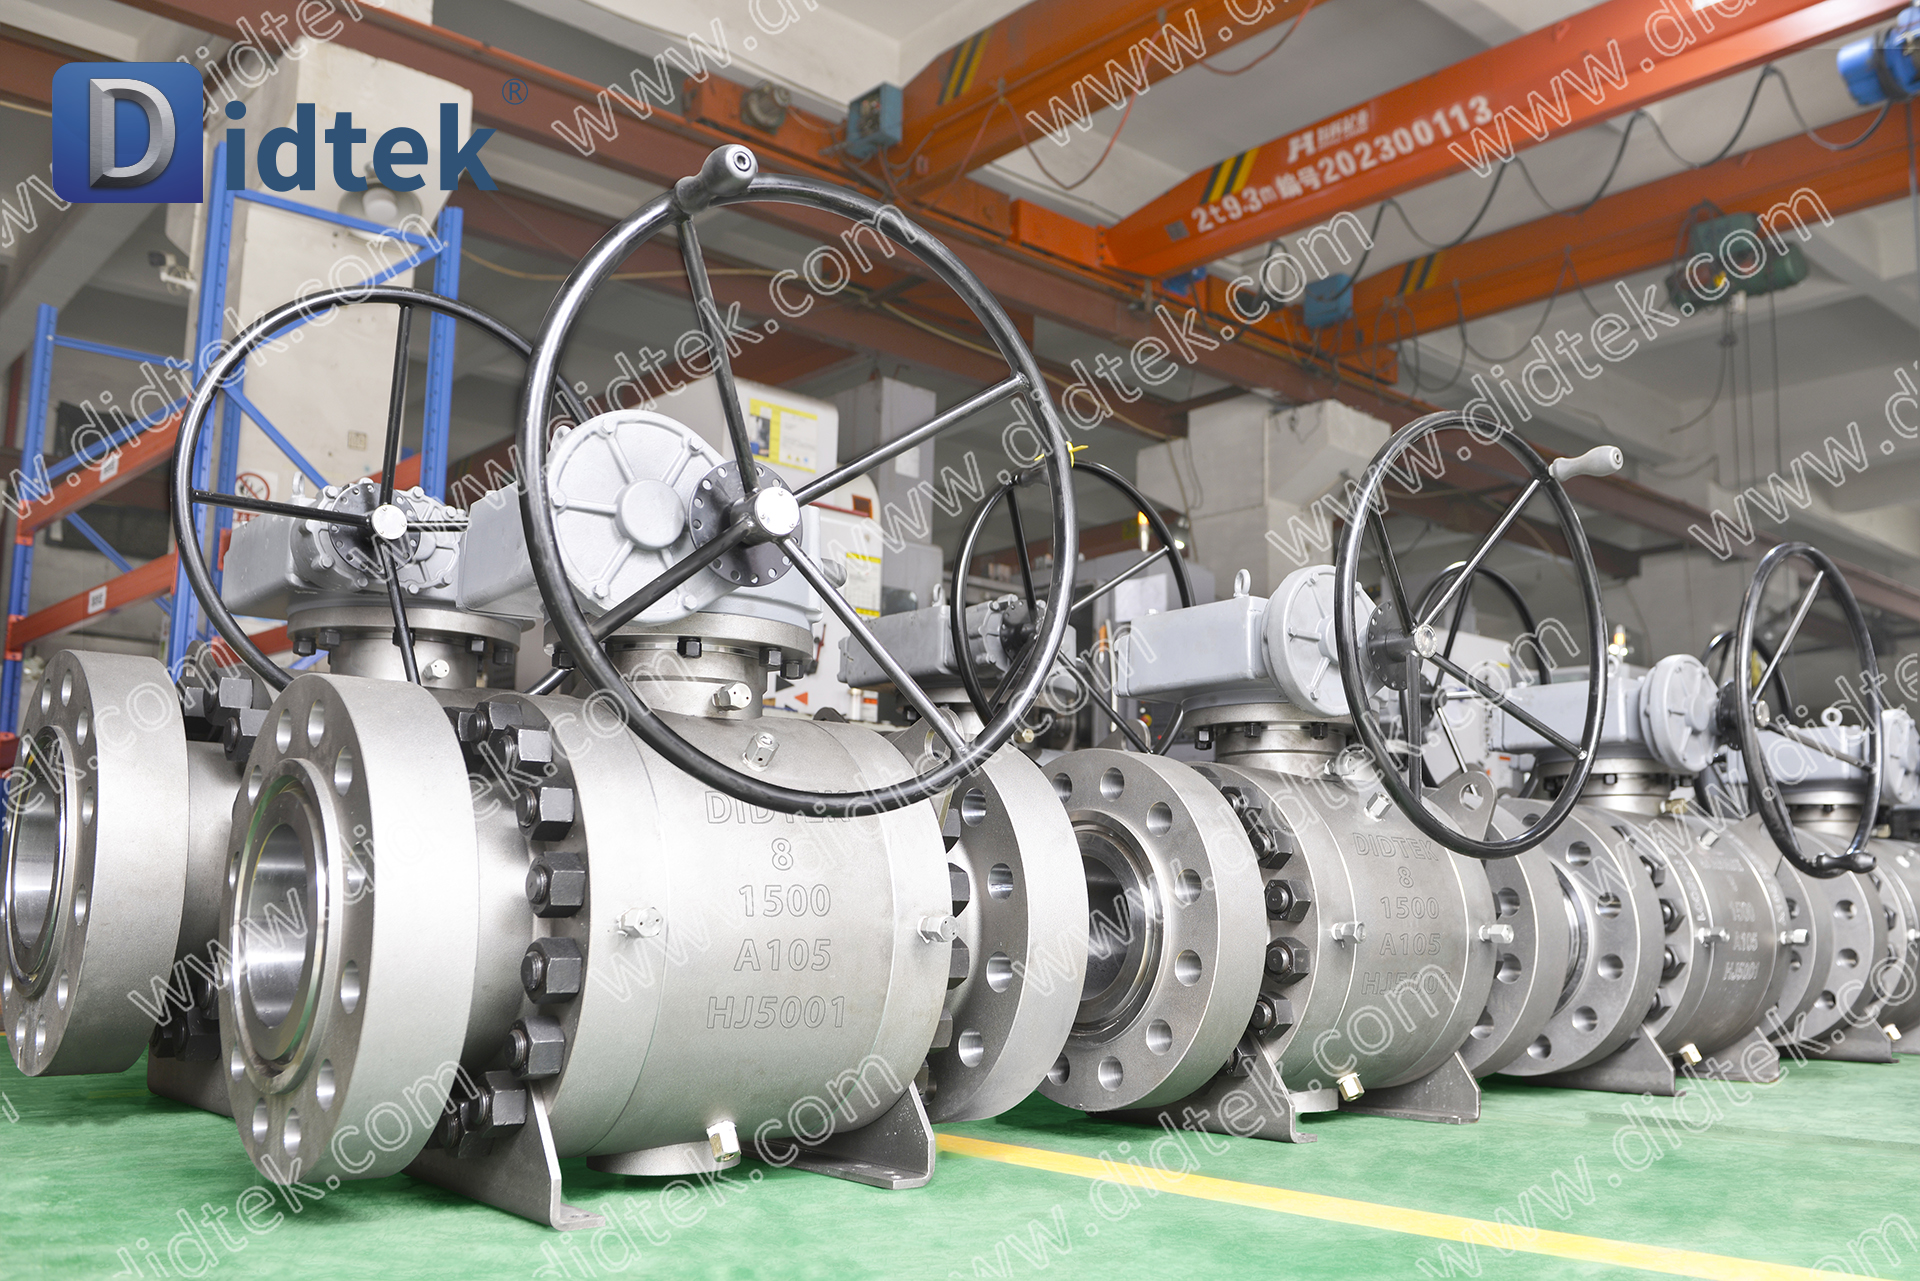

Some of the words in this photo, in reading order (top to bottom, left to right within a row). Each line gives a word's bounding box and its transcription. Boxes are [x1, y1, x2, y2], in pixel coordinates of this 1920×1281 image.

[771, 837, 794, 871] 8
[1352, 832, 1439, 861] DIDTEK
[1398, 865, 1414, 888] 8
[738, 884, 831, 917] 1500
[1379, 896, 1440, 919] 1500
[733, 938, 831, 971] A105
[1379, 933, 1442, 956] A105
[1360, 971, 1453, 995] HJ5001
[706, 996, 845, 1029] HJ5001
